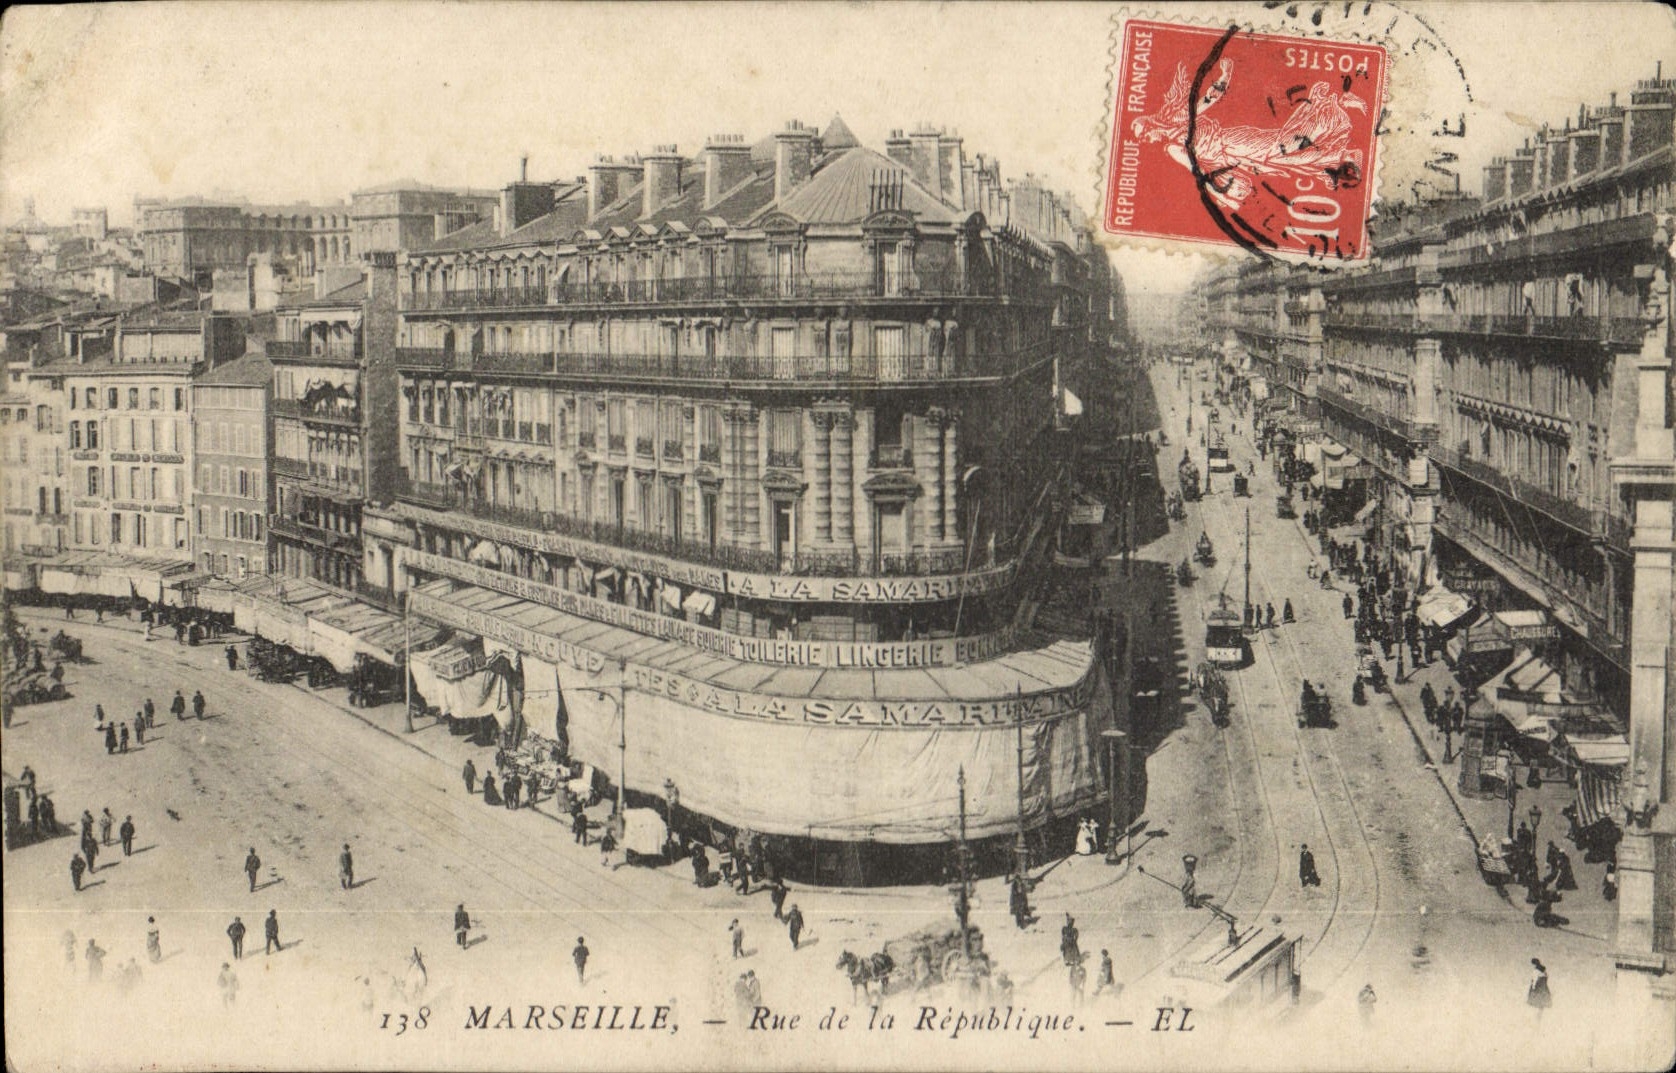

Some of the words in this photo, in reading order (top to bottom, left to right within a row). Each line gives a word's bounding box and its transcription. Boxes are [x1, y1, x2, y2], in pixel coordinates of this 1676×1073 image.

[1127, 30, 1154, 114] FRANÇAISE
[1285, 47, 1370, 74] POSTES
[1114, 138, 1141, 227] REPUBLIQUE
[739, 576, 759, 597] A
[770, 578, 820, 601] LA
[740, 639, 821, 666] TOILERIE
[836, 643, 944, 667] LINGERIE
